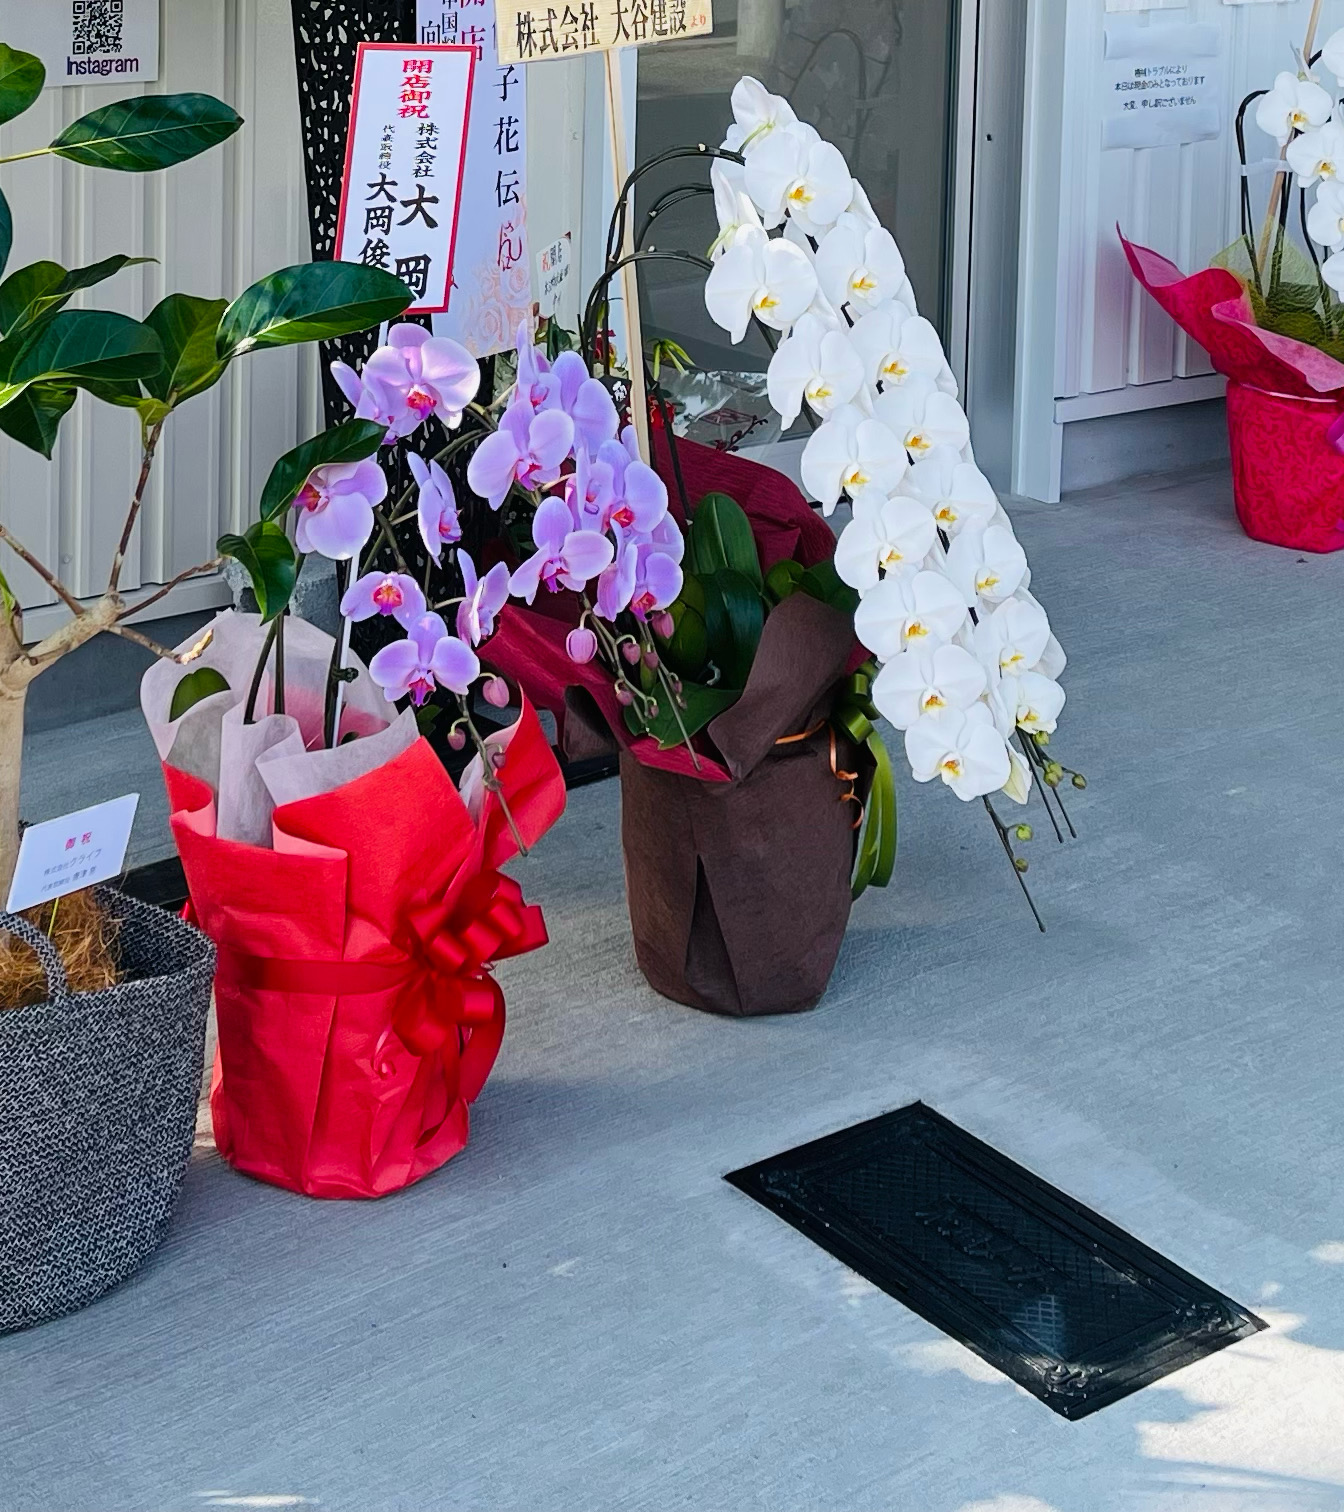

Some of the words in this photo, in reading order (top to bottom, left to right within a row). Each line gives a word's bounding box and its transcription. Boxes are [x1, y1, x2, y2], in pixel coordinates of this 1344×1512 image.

[516, 2, 601, 59] 株式会社
[66, 56, 139, 76] Instagram
[397, 59, 434, 119] 開店御祝
[413, 122, 441, 178] 株式会社
[492, 44, 521, 208] 子花伝
